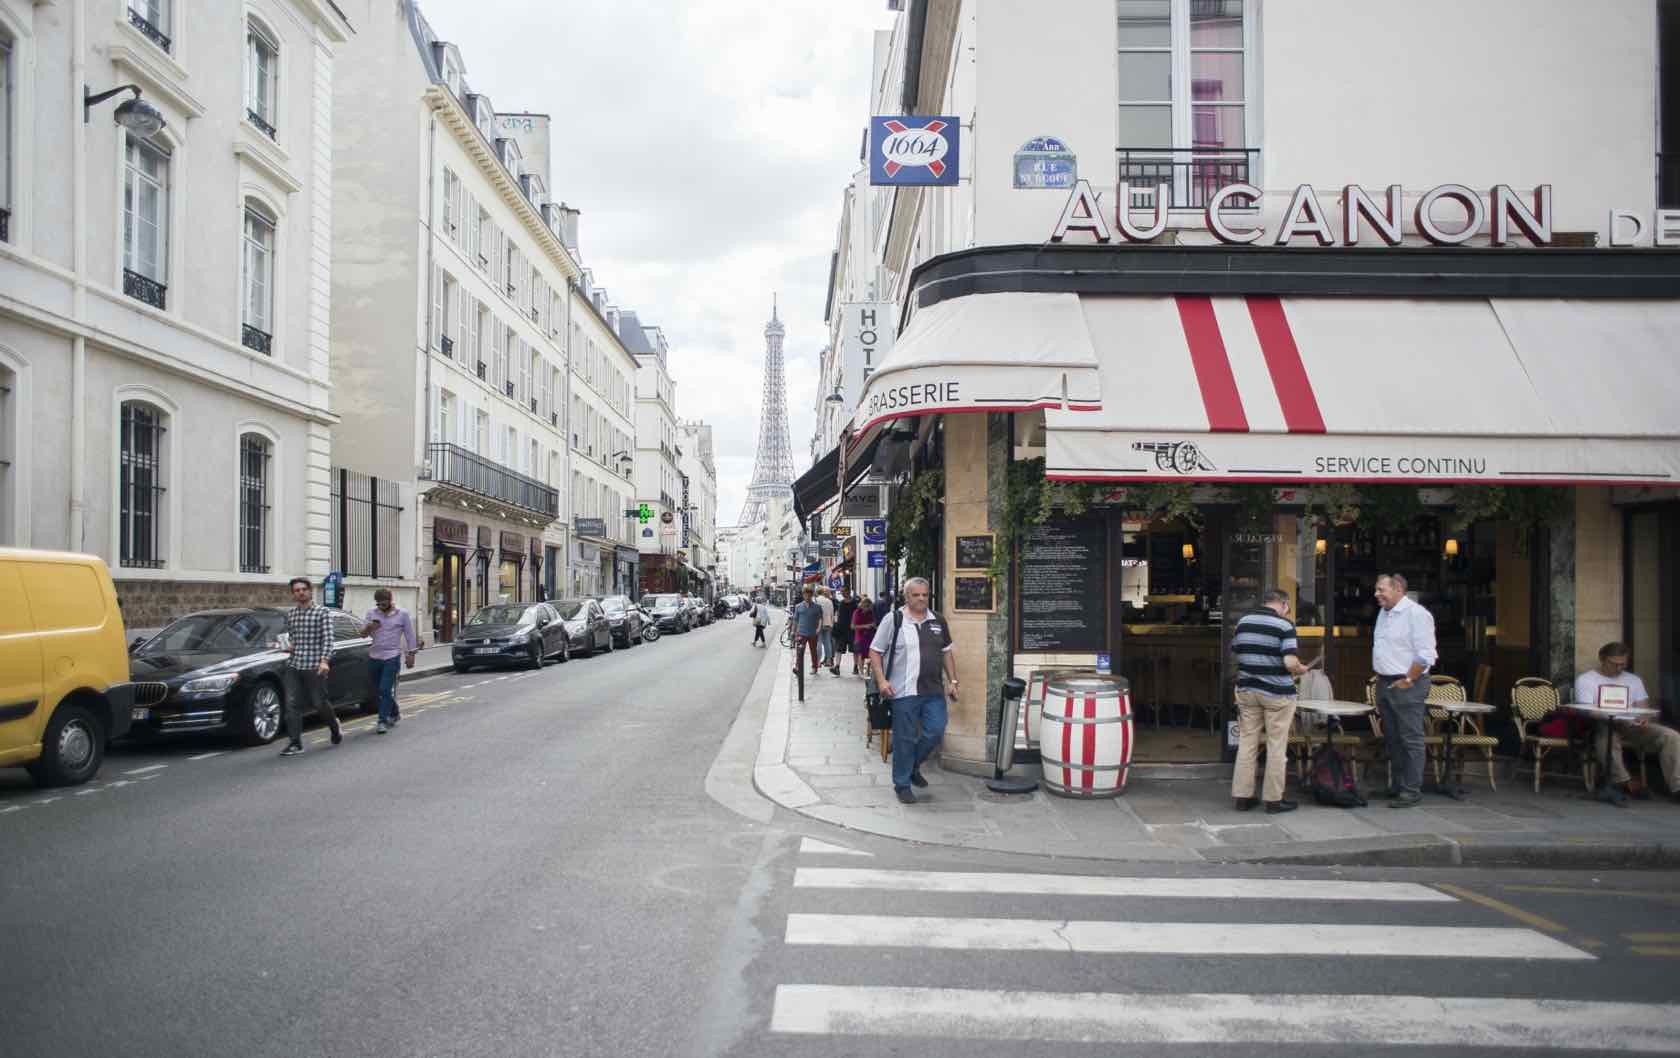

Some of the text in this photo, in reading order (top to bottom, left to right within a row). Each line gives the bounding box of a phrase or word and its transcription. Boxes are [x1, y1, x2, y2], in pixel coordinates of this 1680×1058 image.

[888, 135, 939, 157] 1664
[1050, 178, 1169, 243] AU
[1204, 183, 1553, 247] CANON
[1315, 456, 1486, 475] SERVICE CONTINU
